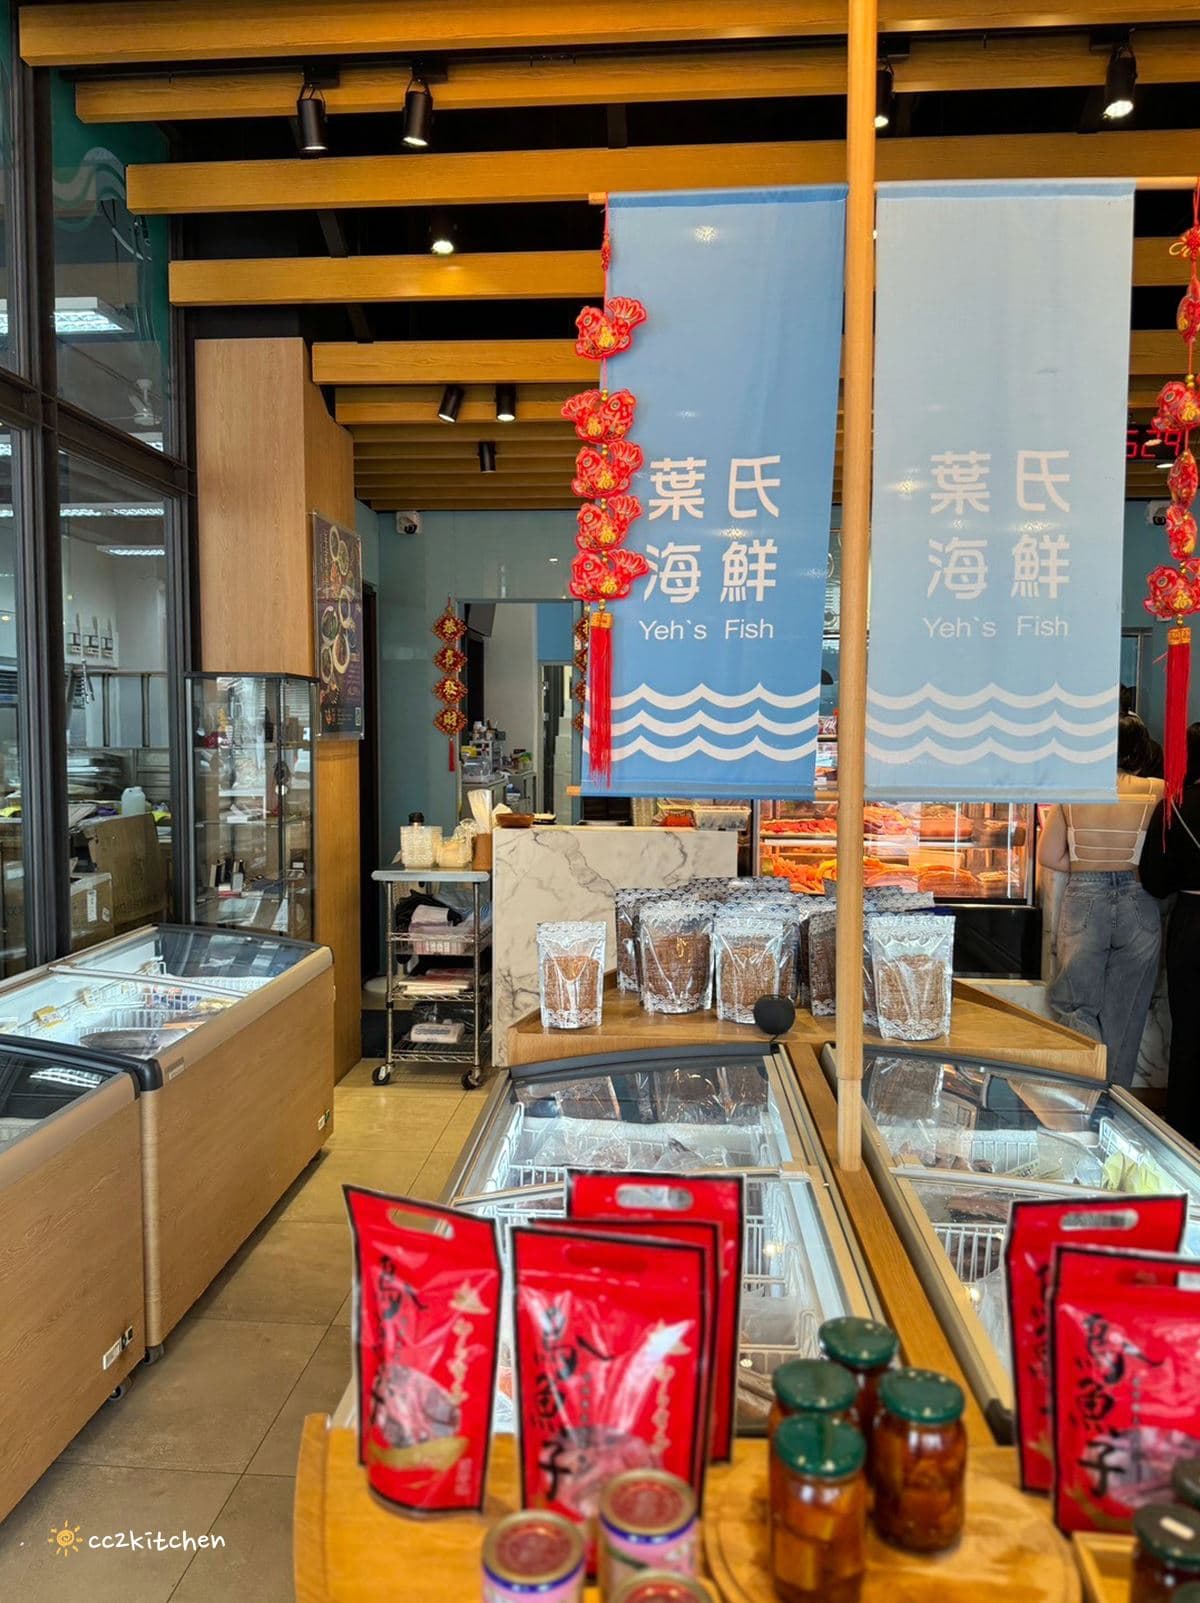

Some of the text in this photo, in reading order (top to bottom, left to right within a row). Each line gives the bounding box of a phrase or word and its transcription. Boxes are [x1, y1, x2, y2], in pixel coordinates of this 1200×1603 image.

[648, 455, 782, 521] 葉氏
[929, 449, 1071, 515] 葉氏
[644, 538, 779, 604] 海鮮
[926, 534, 1071, 600] 海鮮
[724, 618, 775, 640] Fish
[1016, 615, 1069, 637] Fish
